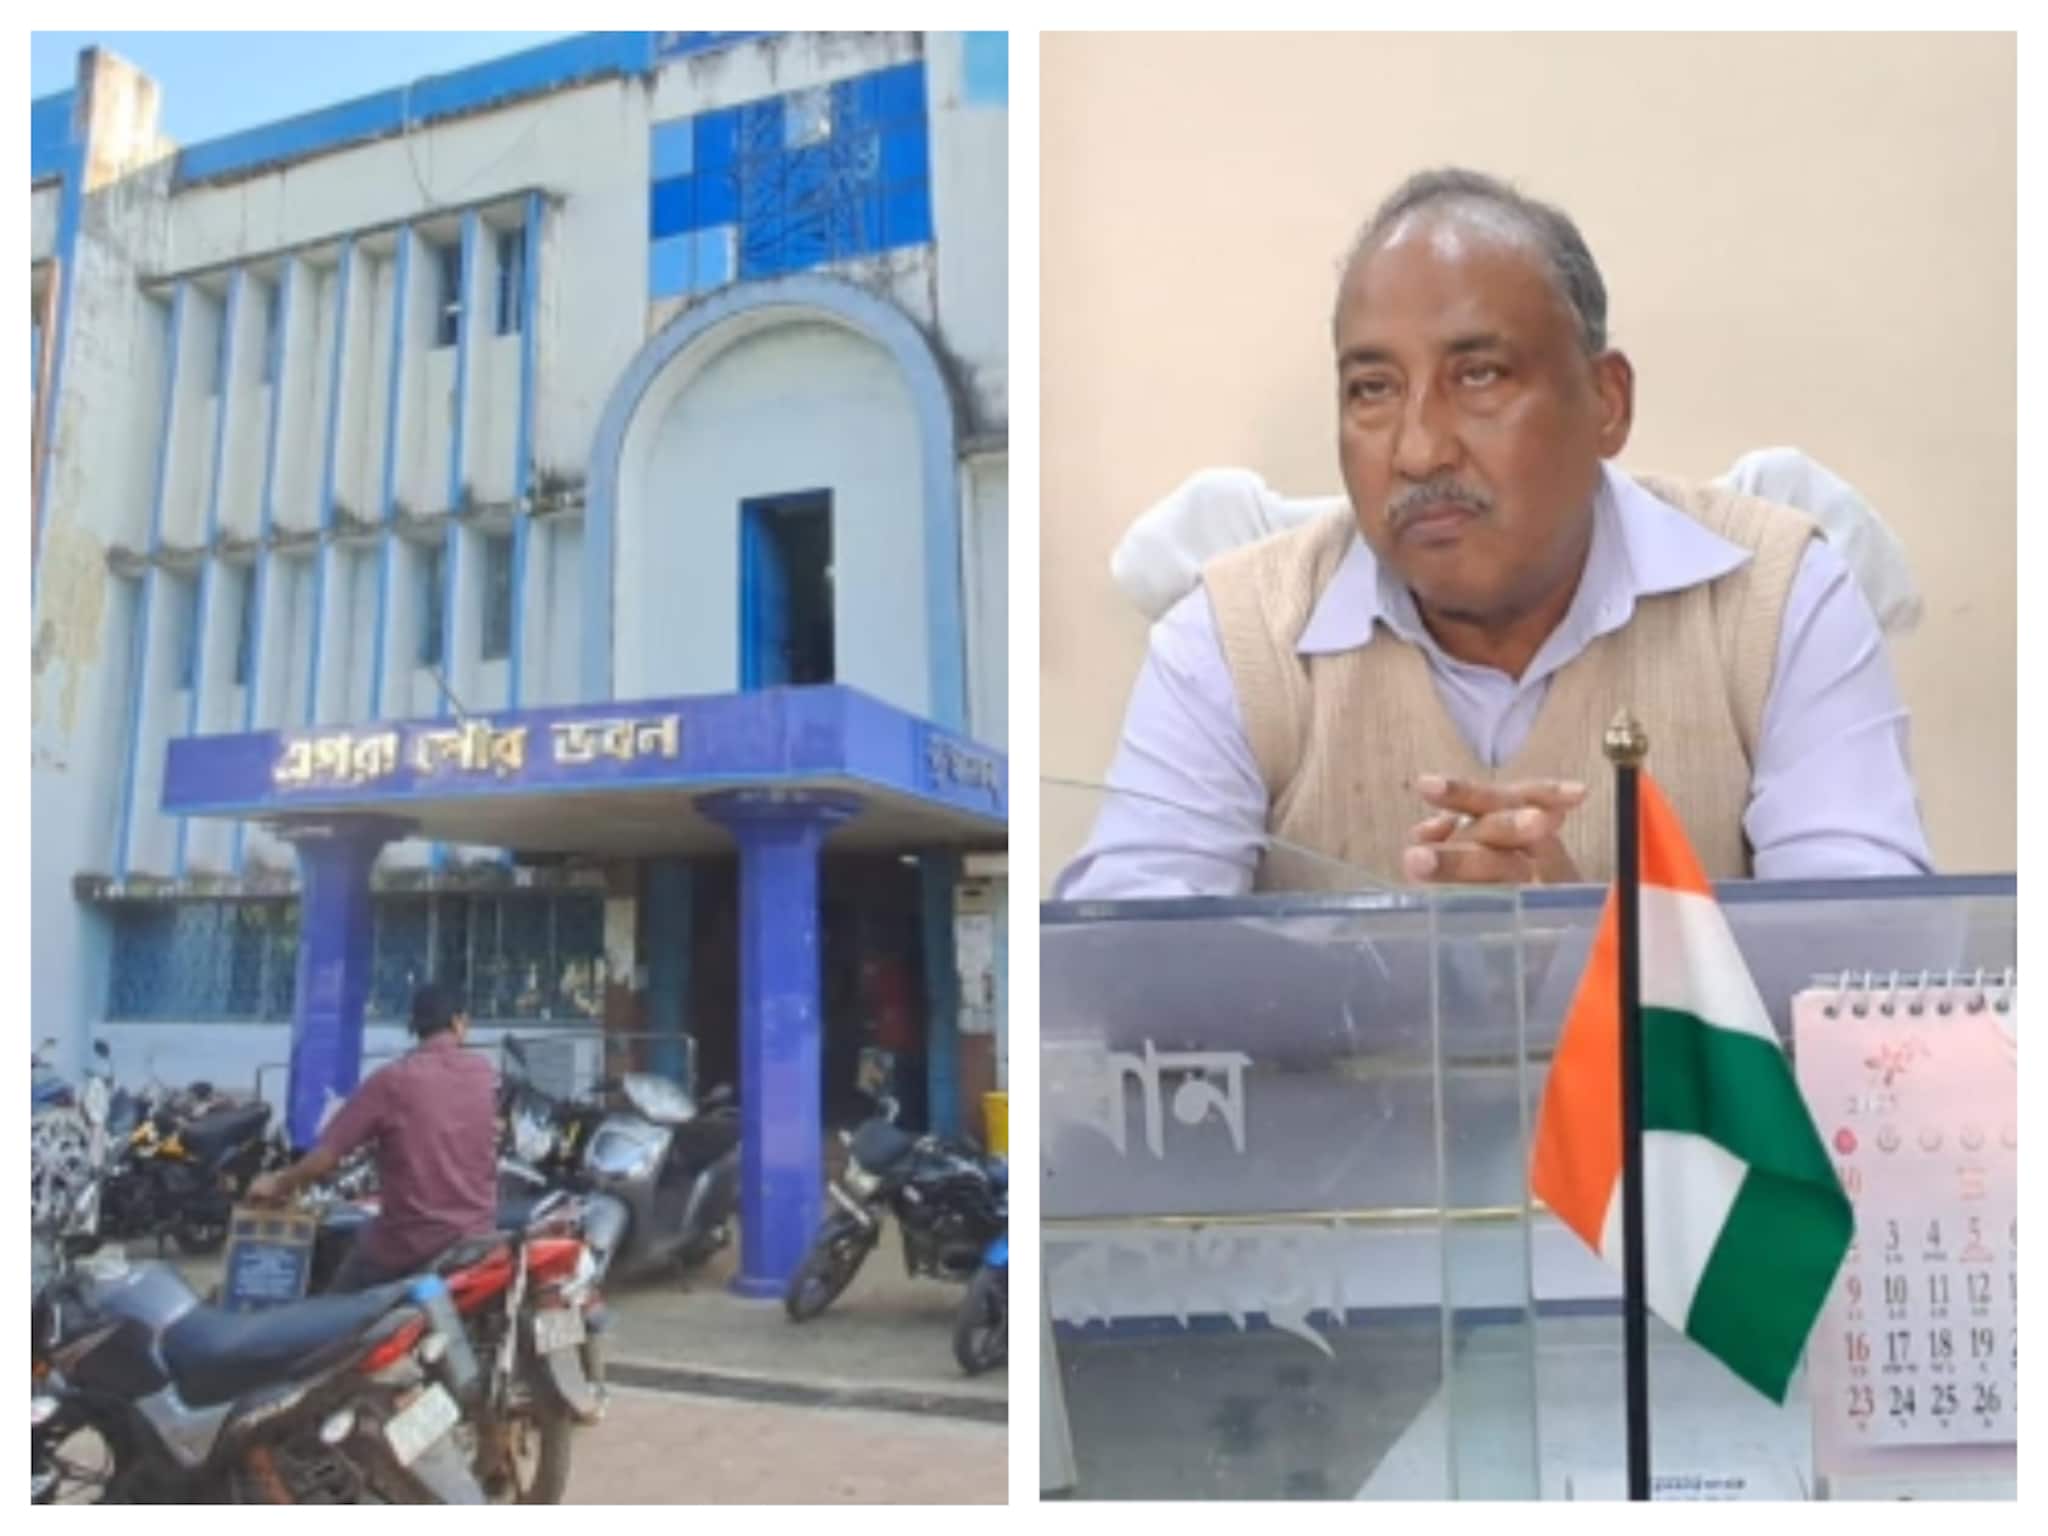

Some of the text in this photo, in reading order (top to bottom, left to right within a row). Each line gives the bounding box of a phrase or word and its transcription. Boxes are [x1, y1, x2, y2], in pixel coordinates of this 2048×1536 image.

[415, 718, 528, 778] পৌর
[551, 713, 680, 762] ভবন
[1885, 1217, 1900, 1251] 3
[1926, 1218, 1942, 1249] 4
[1967, 1216, 1983, 1249] 5
[1845, 1274, 1862, 1305] 9
[1883, 1273, 1908, 1305] 10
[1927, 1272, 1951, 1305] 11
[1967, 1271, 1992, 1304] 12
[1843, 1330, 1871, 1363] 16
[1887, 1330, 1912, 1362] 17
[1928, 1328, 1953, 1360] 18
[1970, 1327, 1995, 1358] 19
[1847, 1380, 2002, 1417] 23 24 25 26
